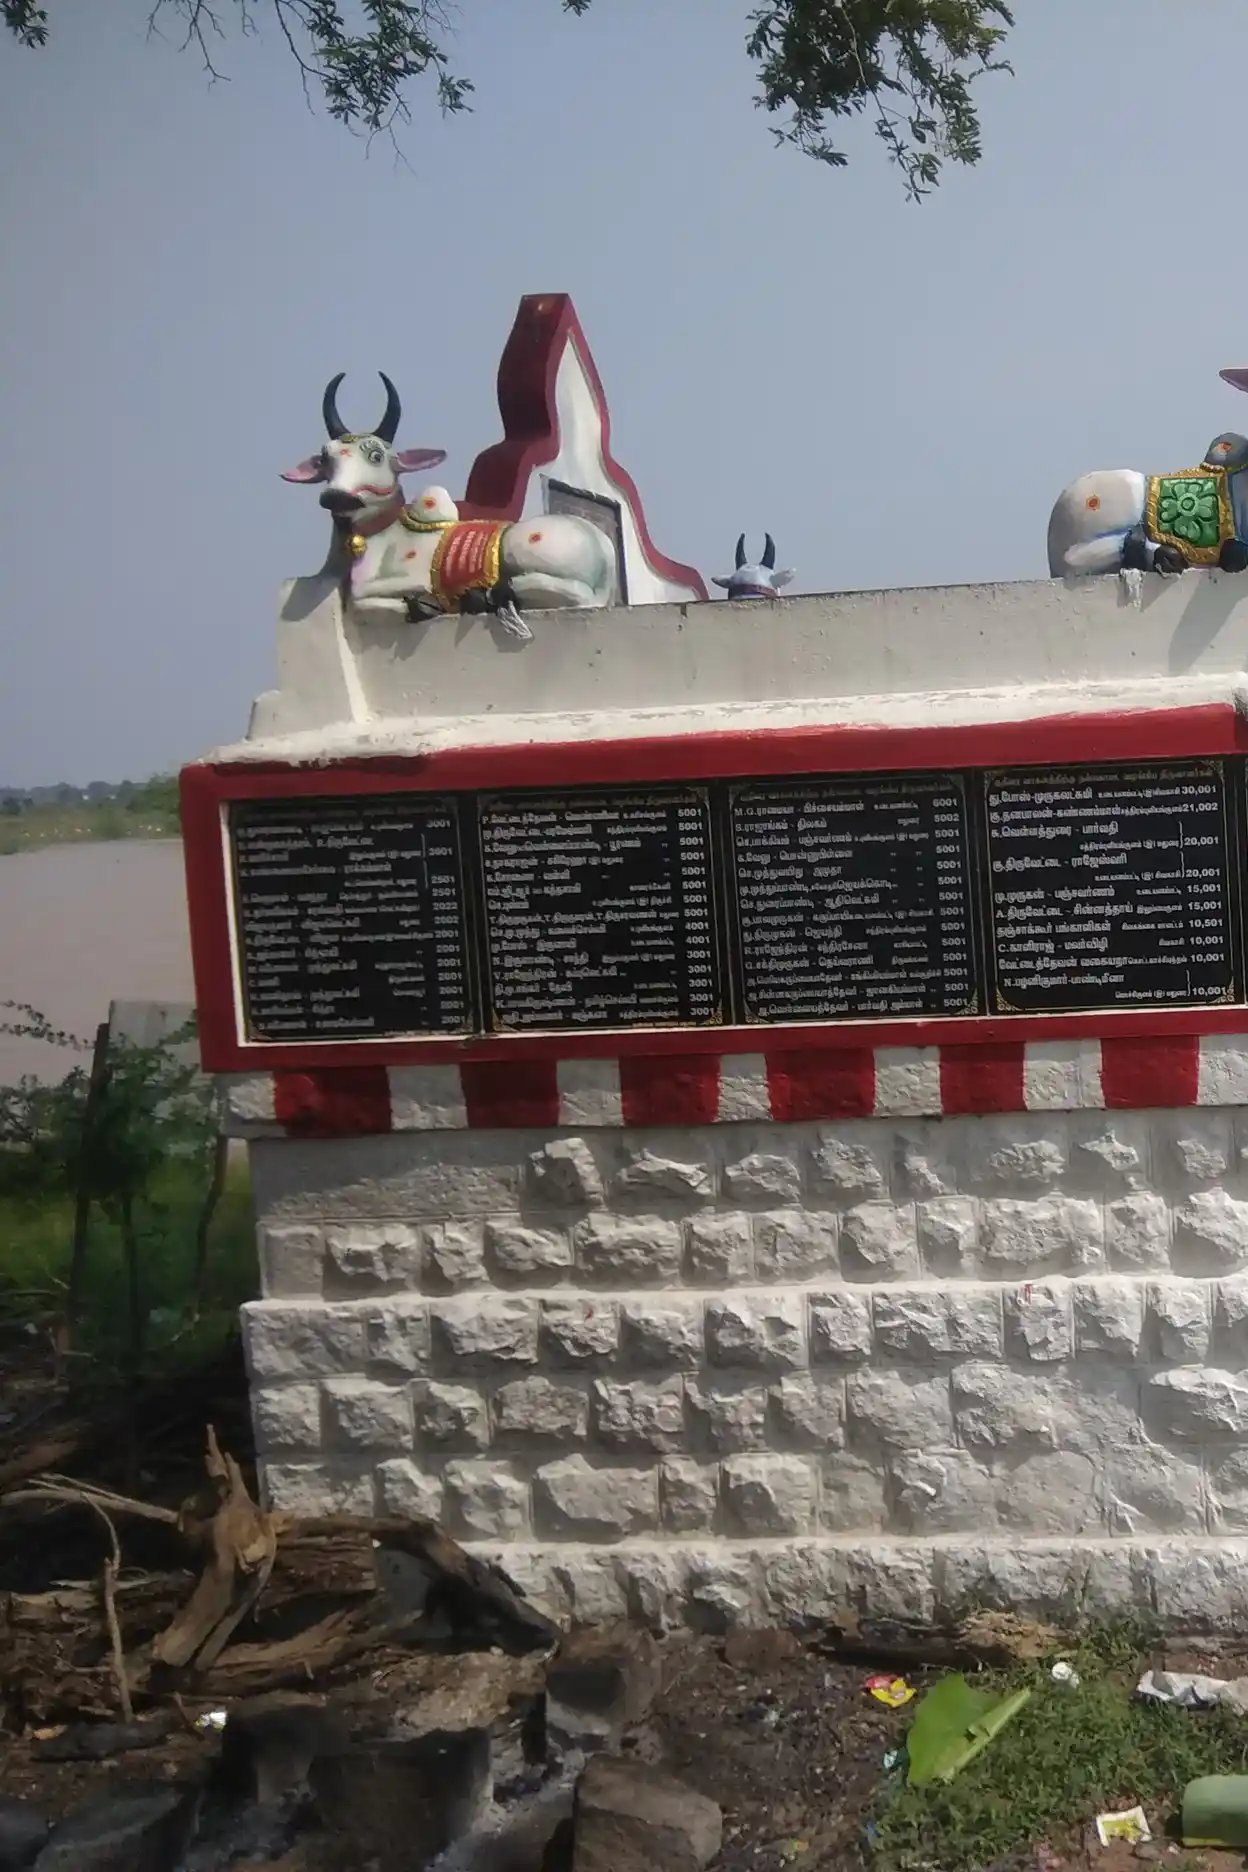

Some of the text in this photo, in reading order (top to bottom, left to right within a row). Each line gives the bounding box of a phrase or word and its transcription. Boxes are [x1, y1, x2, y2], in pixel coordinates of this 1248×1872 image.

[1182, 785, 1217, 796] 30,001
[932, 798, 958, 808] 6001
[1182, 802, 1218, 813] 21,002
[678, 808, 702, 817] 5001
[934, 813, 960, 823] 5002
[678, 822, 703, 831] 5001
[934, 828, 960, 838] 5001
[680, 836, 704, 846] 5001
[1184, 836, 1219, 847] 20,001
[936, 844, 960, 854] 5001
[680, 852, 704, 860] 5001
[936, 860, 962, 870] 5001
[681, 866, 706, 876] 5001
[1186, 868, 1220, 878] 20,001
[682, 880, 706, 890] 5001
[938, 876, 962, 886] 5001
[1187, 884, 1222, 894] 15,001
[683, 894, 708, 903] 5001
[939, 892, 964, 901] 5001
[1188, 900, 1222, 912] 15,001
[684, 908, 708, 917] 5001
[940, 907, 964, 916] 5001
[685, 922, 709, 930] 4001
[940, 922, 966, 931] 5001
[1189, 918, 1223, 928] 10,501
[686, 936, 710, 944] 4001
[941, 937, 966, 946] 5001
[1190, 936, 1224, 946] 10,001
[686, 950, 711, 959] 3001
[943, 952, 967, 962] 5001
[1190, 953, 1225, 964] 10,001
[688, 965, 712, 974] 3001
[944, 968, 968, 976] 5001
[688, 978, 713, 987] 3001
[944, 982, 968, 992] 5001
[1192, 986, 1227, 996] 10,001
[690, 994, 714, 1002] 3001
[944, 998, 968, 1008] 5001
[690, 1008, 714, 1016] 3001
